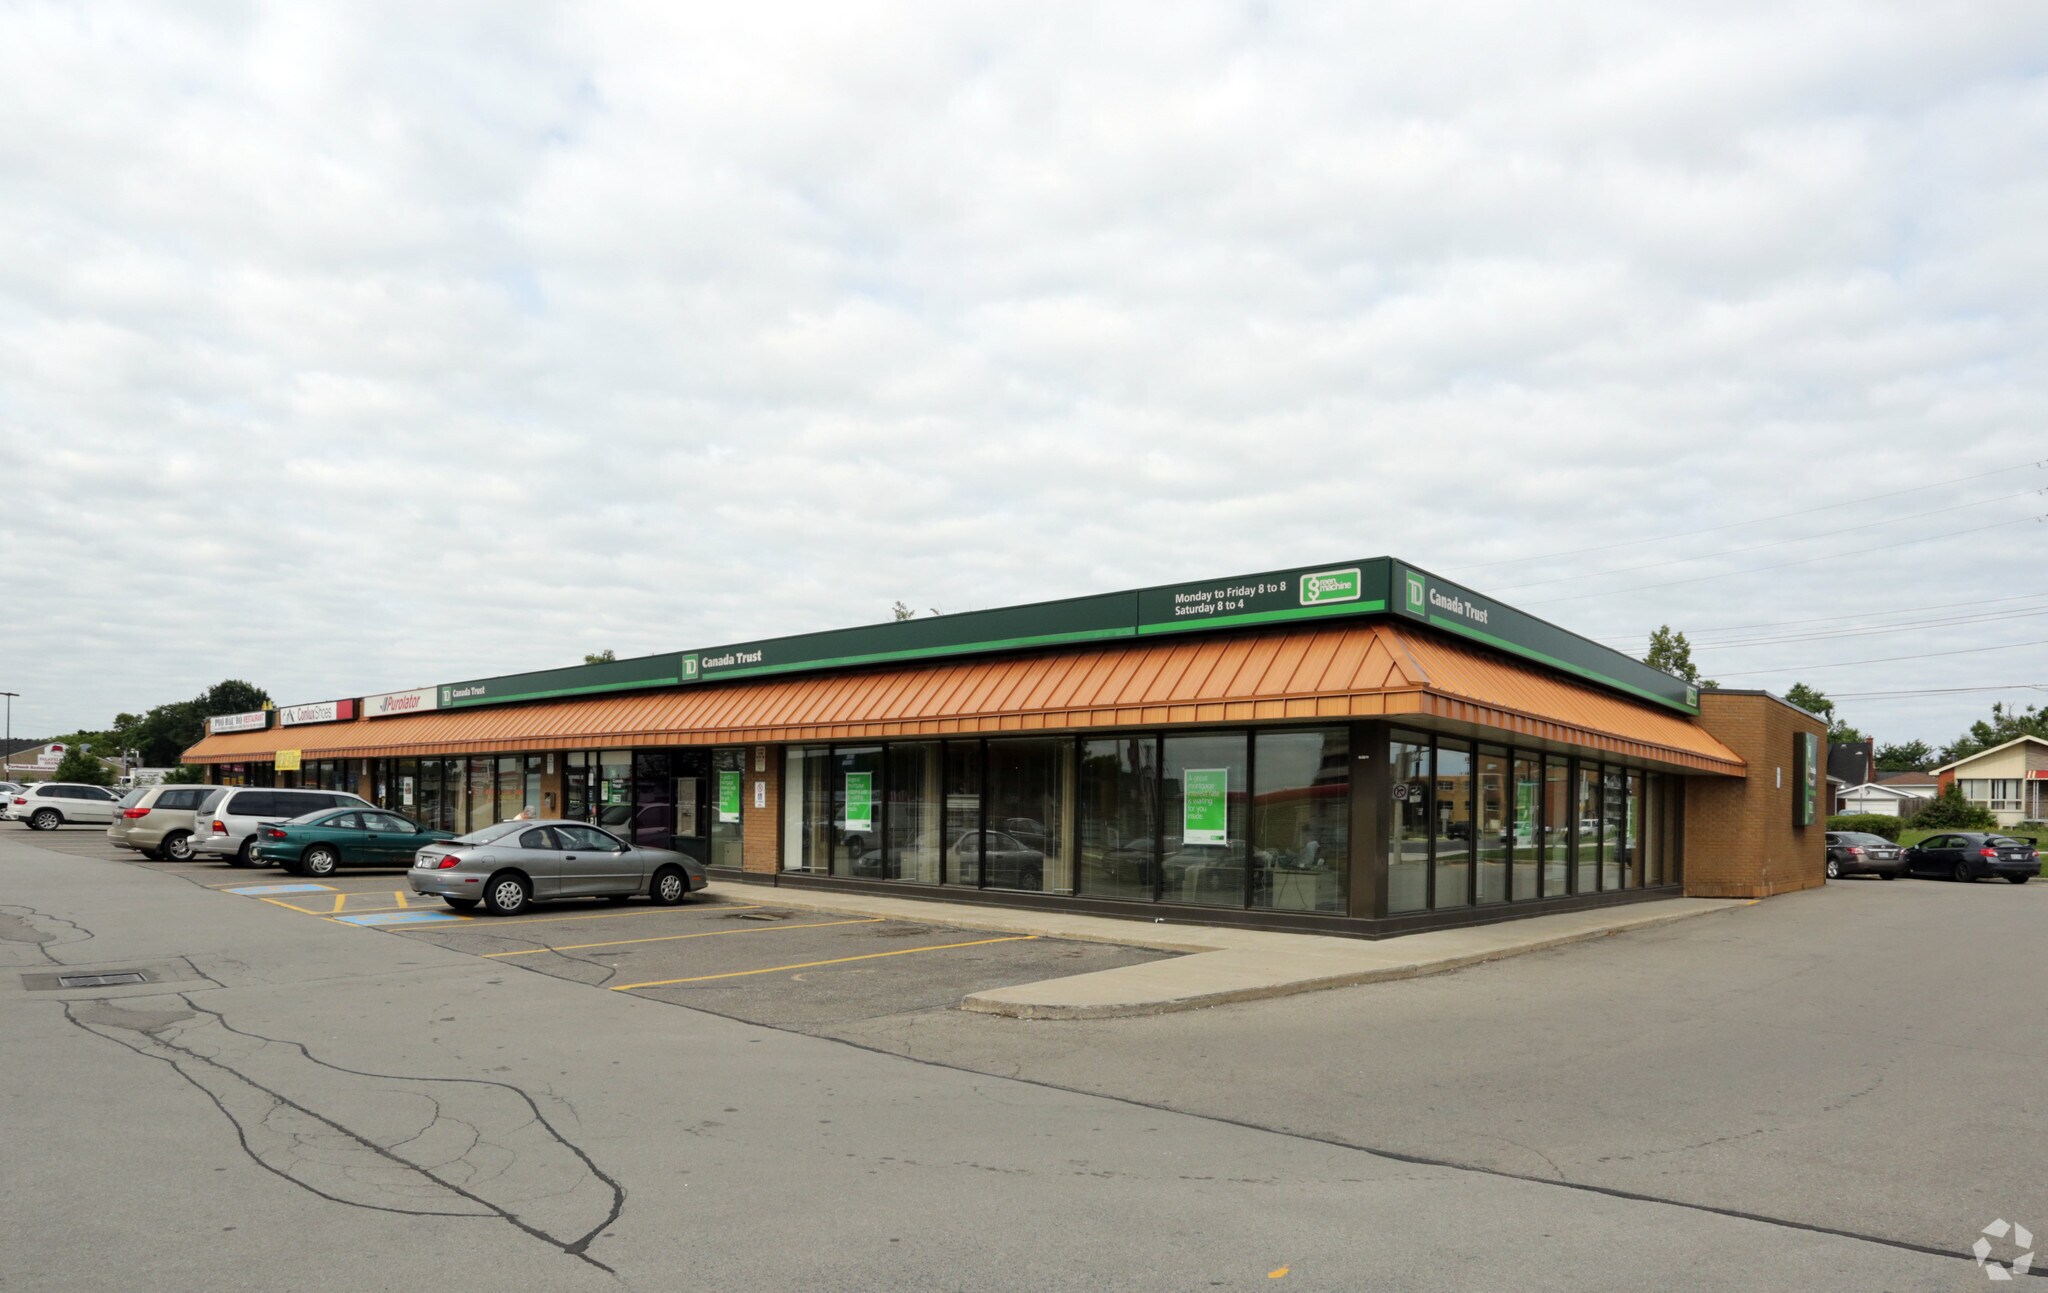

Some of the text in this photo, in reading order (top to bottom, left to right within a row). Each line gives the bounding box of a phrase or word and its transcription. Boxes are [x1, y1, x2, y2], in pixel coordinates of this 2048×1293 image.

[1175, 581, 1287, 603] Monday to Friday 8 to 8
[1320, 582, 1351, 592] machine
[1408, 579, 1423, 607] TD
[1175, 598, 1244, 616] Saturday 8 to 4
[1429, 588, 1488, 624] Canada Trust
[684, 659, 697, 675] TD
[702, 650, 762, 668] Canada Trust
[443, 690, 451, 702] TD
[452, 686, 485, 697] Canada Trust
[387, 696, 421, 711] Purolator
